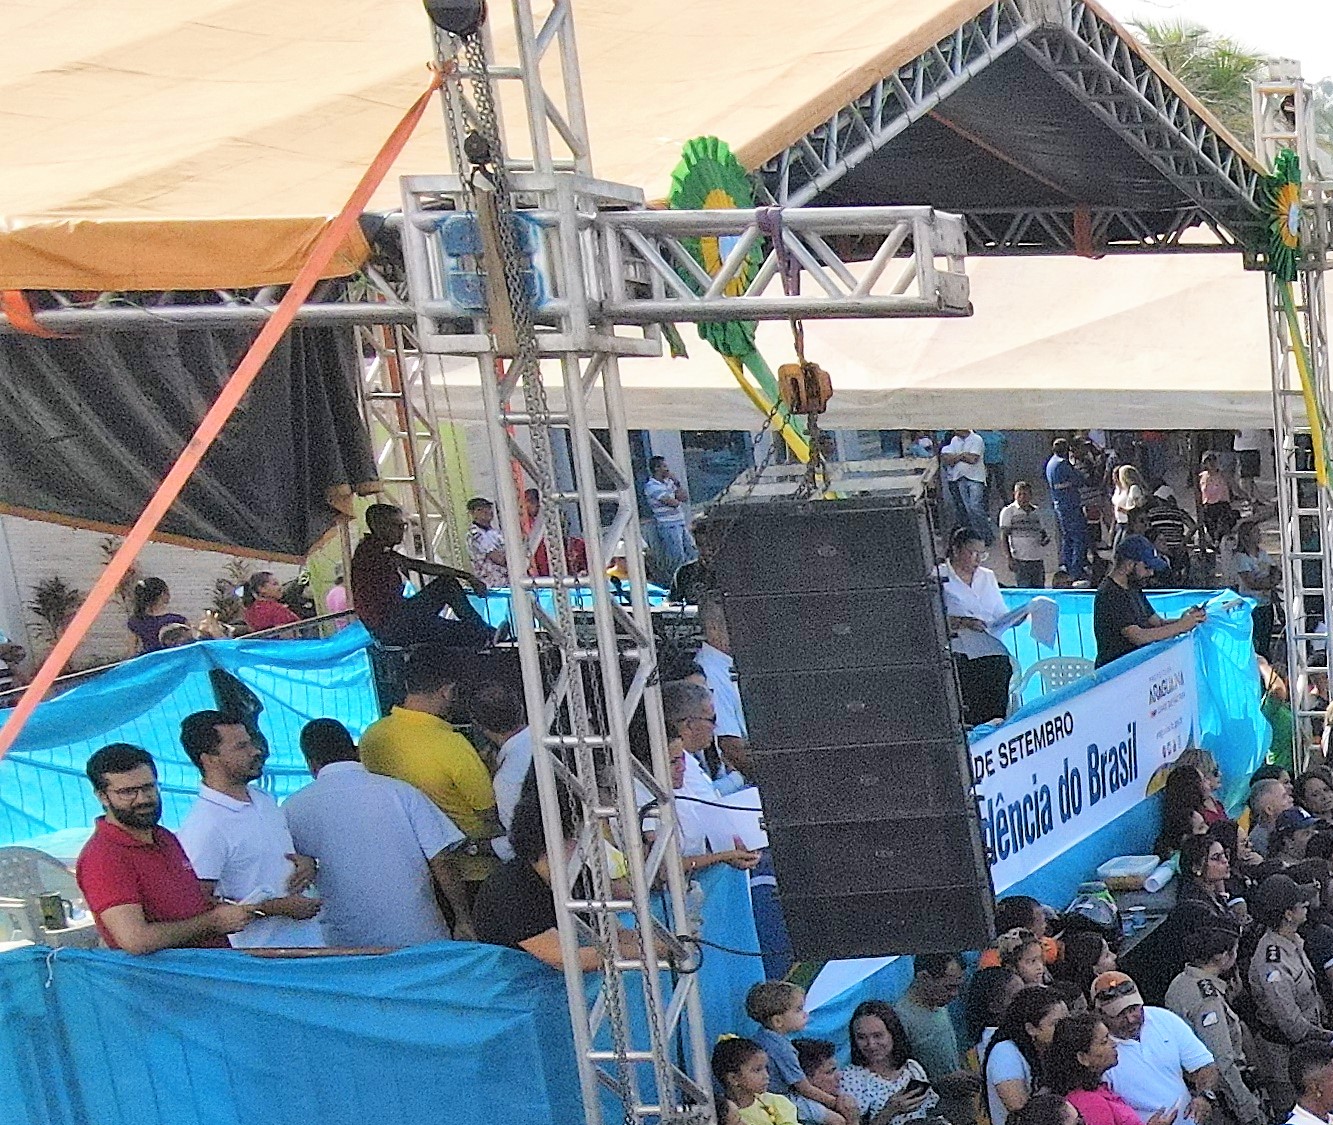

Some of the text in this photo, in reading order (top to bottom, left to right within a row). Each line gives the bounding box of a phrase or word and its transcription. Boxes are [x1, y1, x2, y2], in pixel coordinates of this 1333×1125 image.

[974, 711, 1074, 779] DE SETEMBRO
[980, 721, 1139, 866] dência do Brasil
